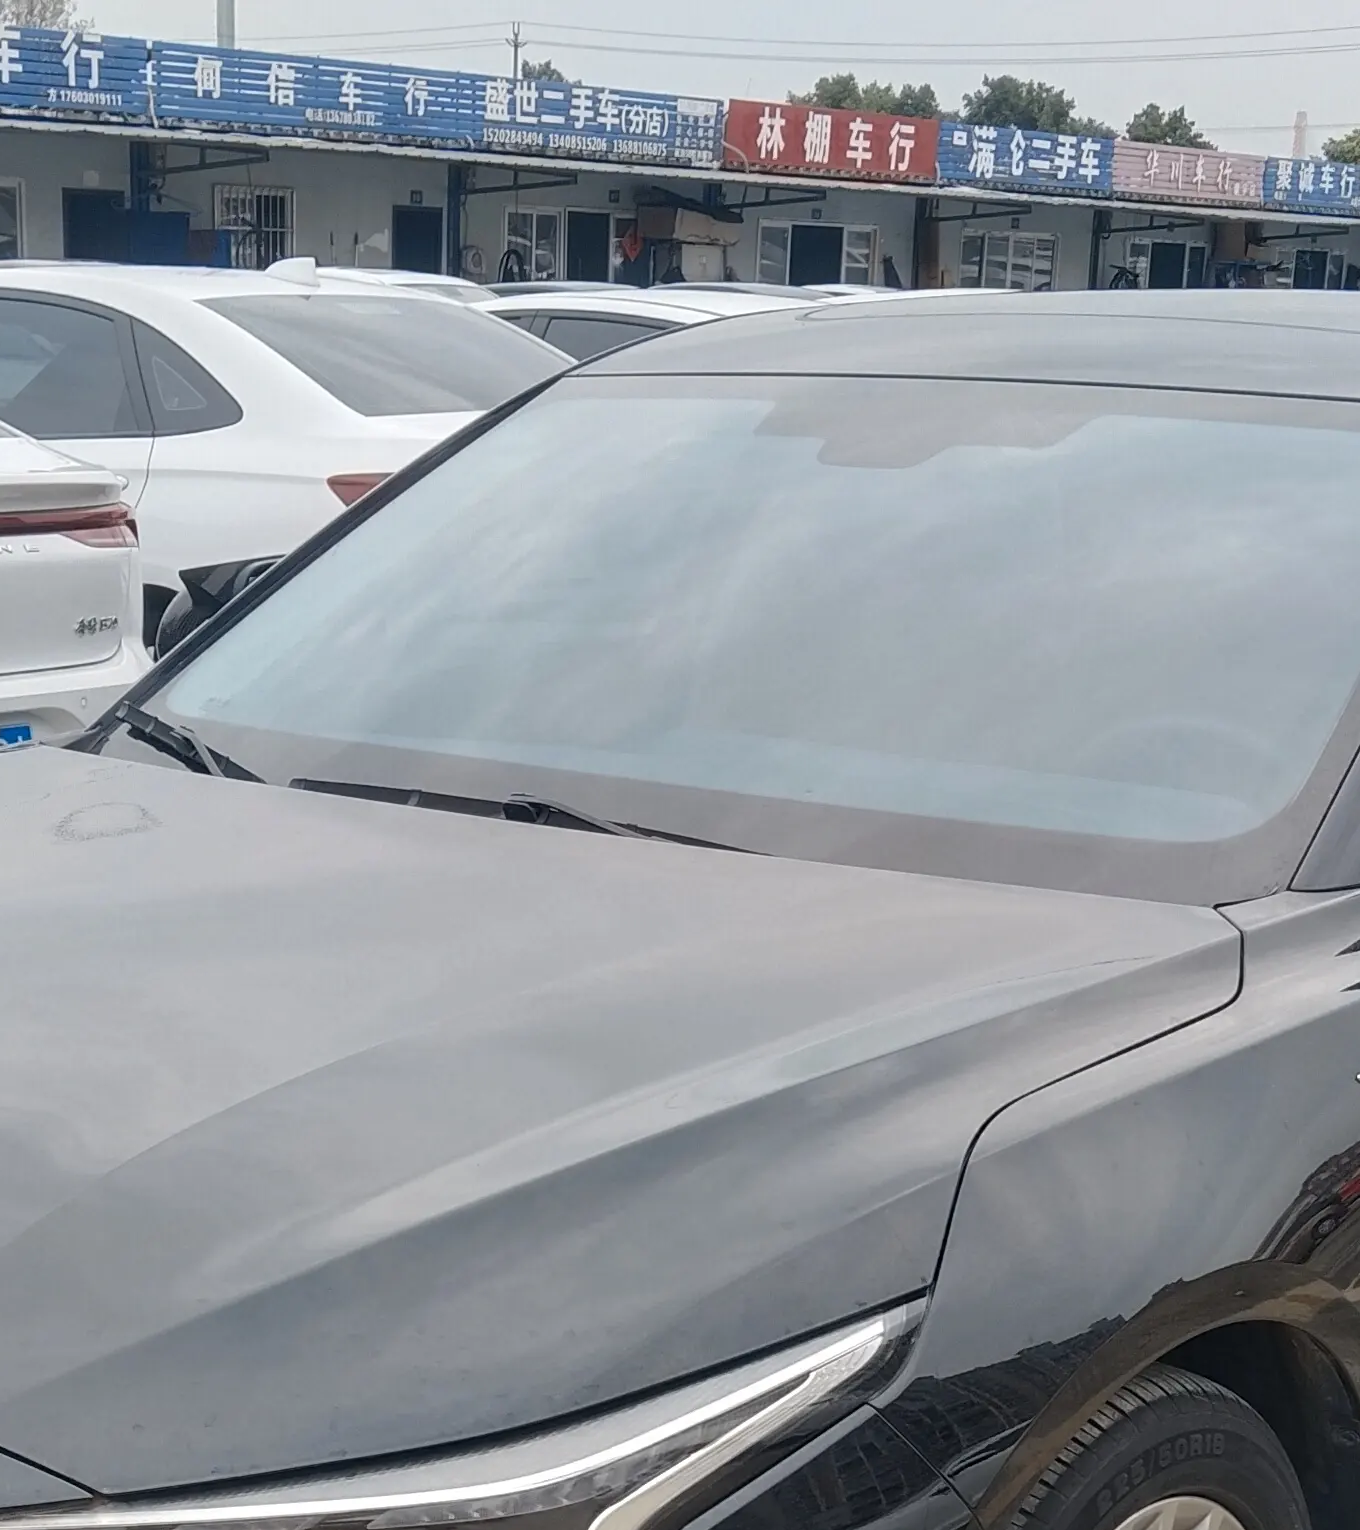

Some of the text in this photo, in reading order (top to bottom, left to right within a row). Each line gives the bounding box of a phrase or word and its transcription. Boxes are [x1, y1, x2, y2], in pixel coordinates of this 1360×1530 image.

[756, 106, 916, 172] 林棚车行
[1144, 149, 1233, 193] 华川车行
[1275, 159, 1356, 198] 聚诚车行
